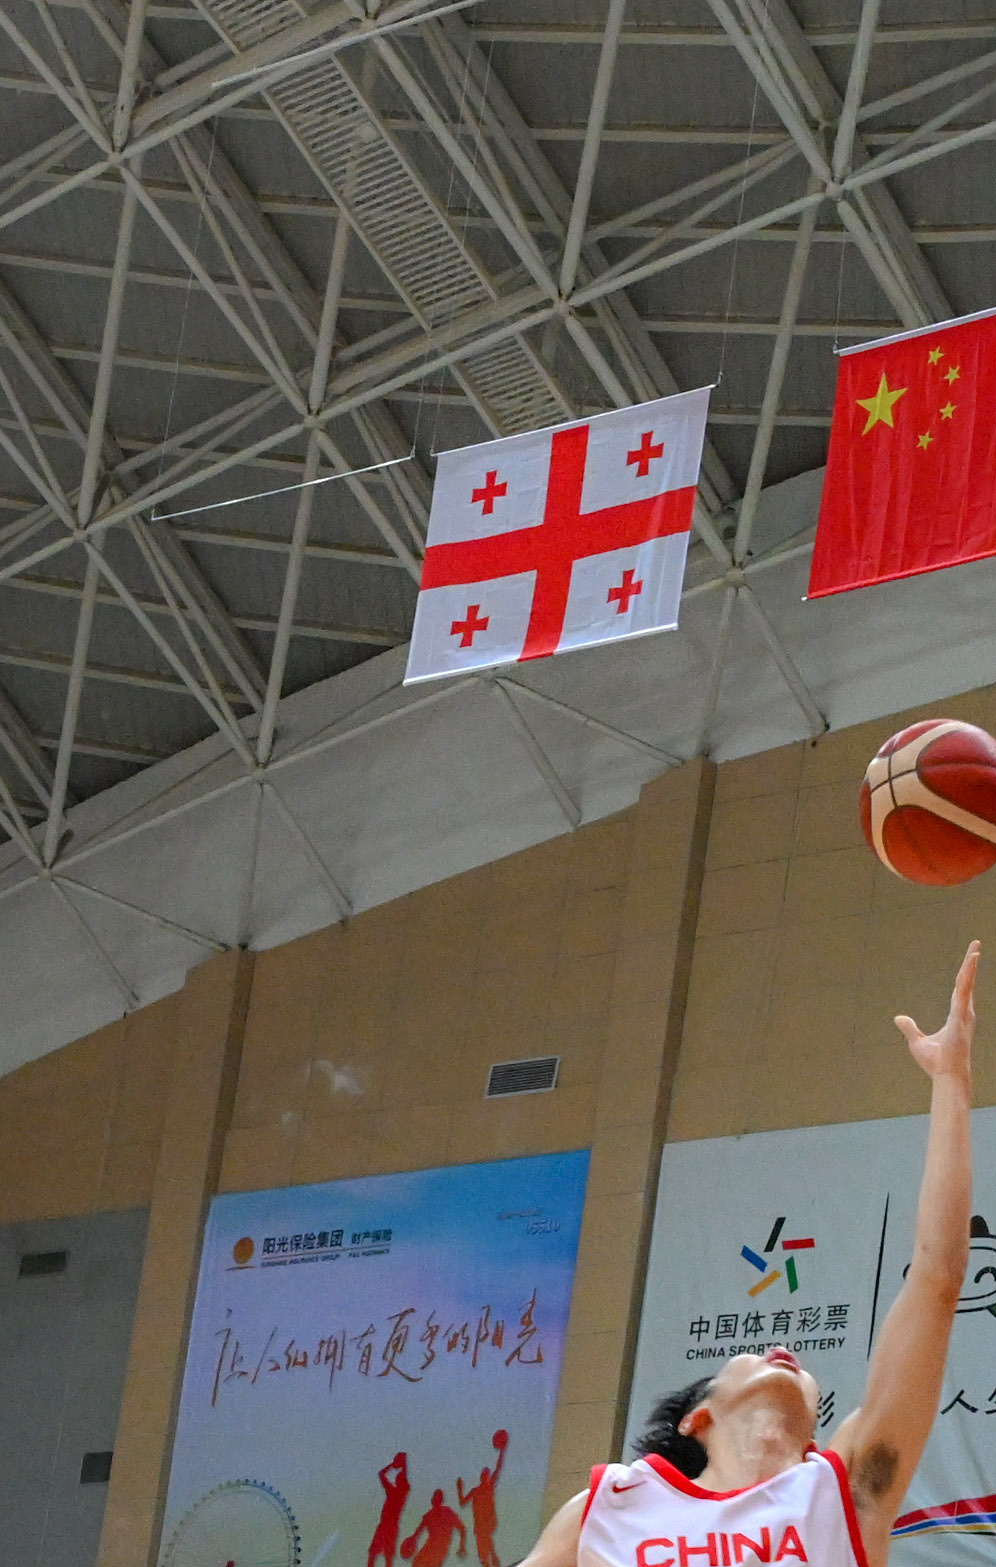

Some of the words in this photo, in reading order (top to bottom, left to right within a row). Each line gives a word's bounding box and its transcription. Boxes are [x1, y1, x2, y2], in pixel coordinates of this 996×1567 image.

[261, 1229, 344, 1255] 阳光保险集团
[689, 1304, 851, 1343] 中国体育彩票
[686, 1348, 726, 1361] CHINA
[786, 1337, 847, 1352] LOTTERY
